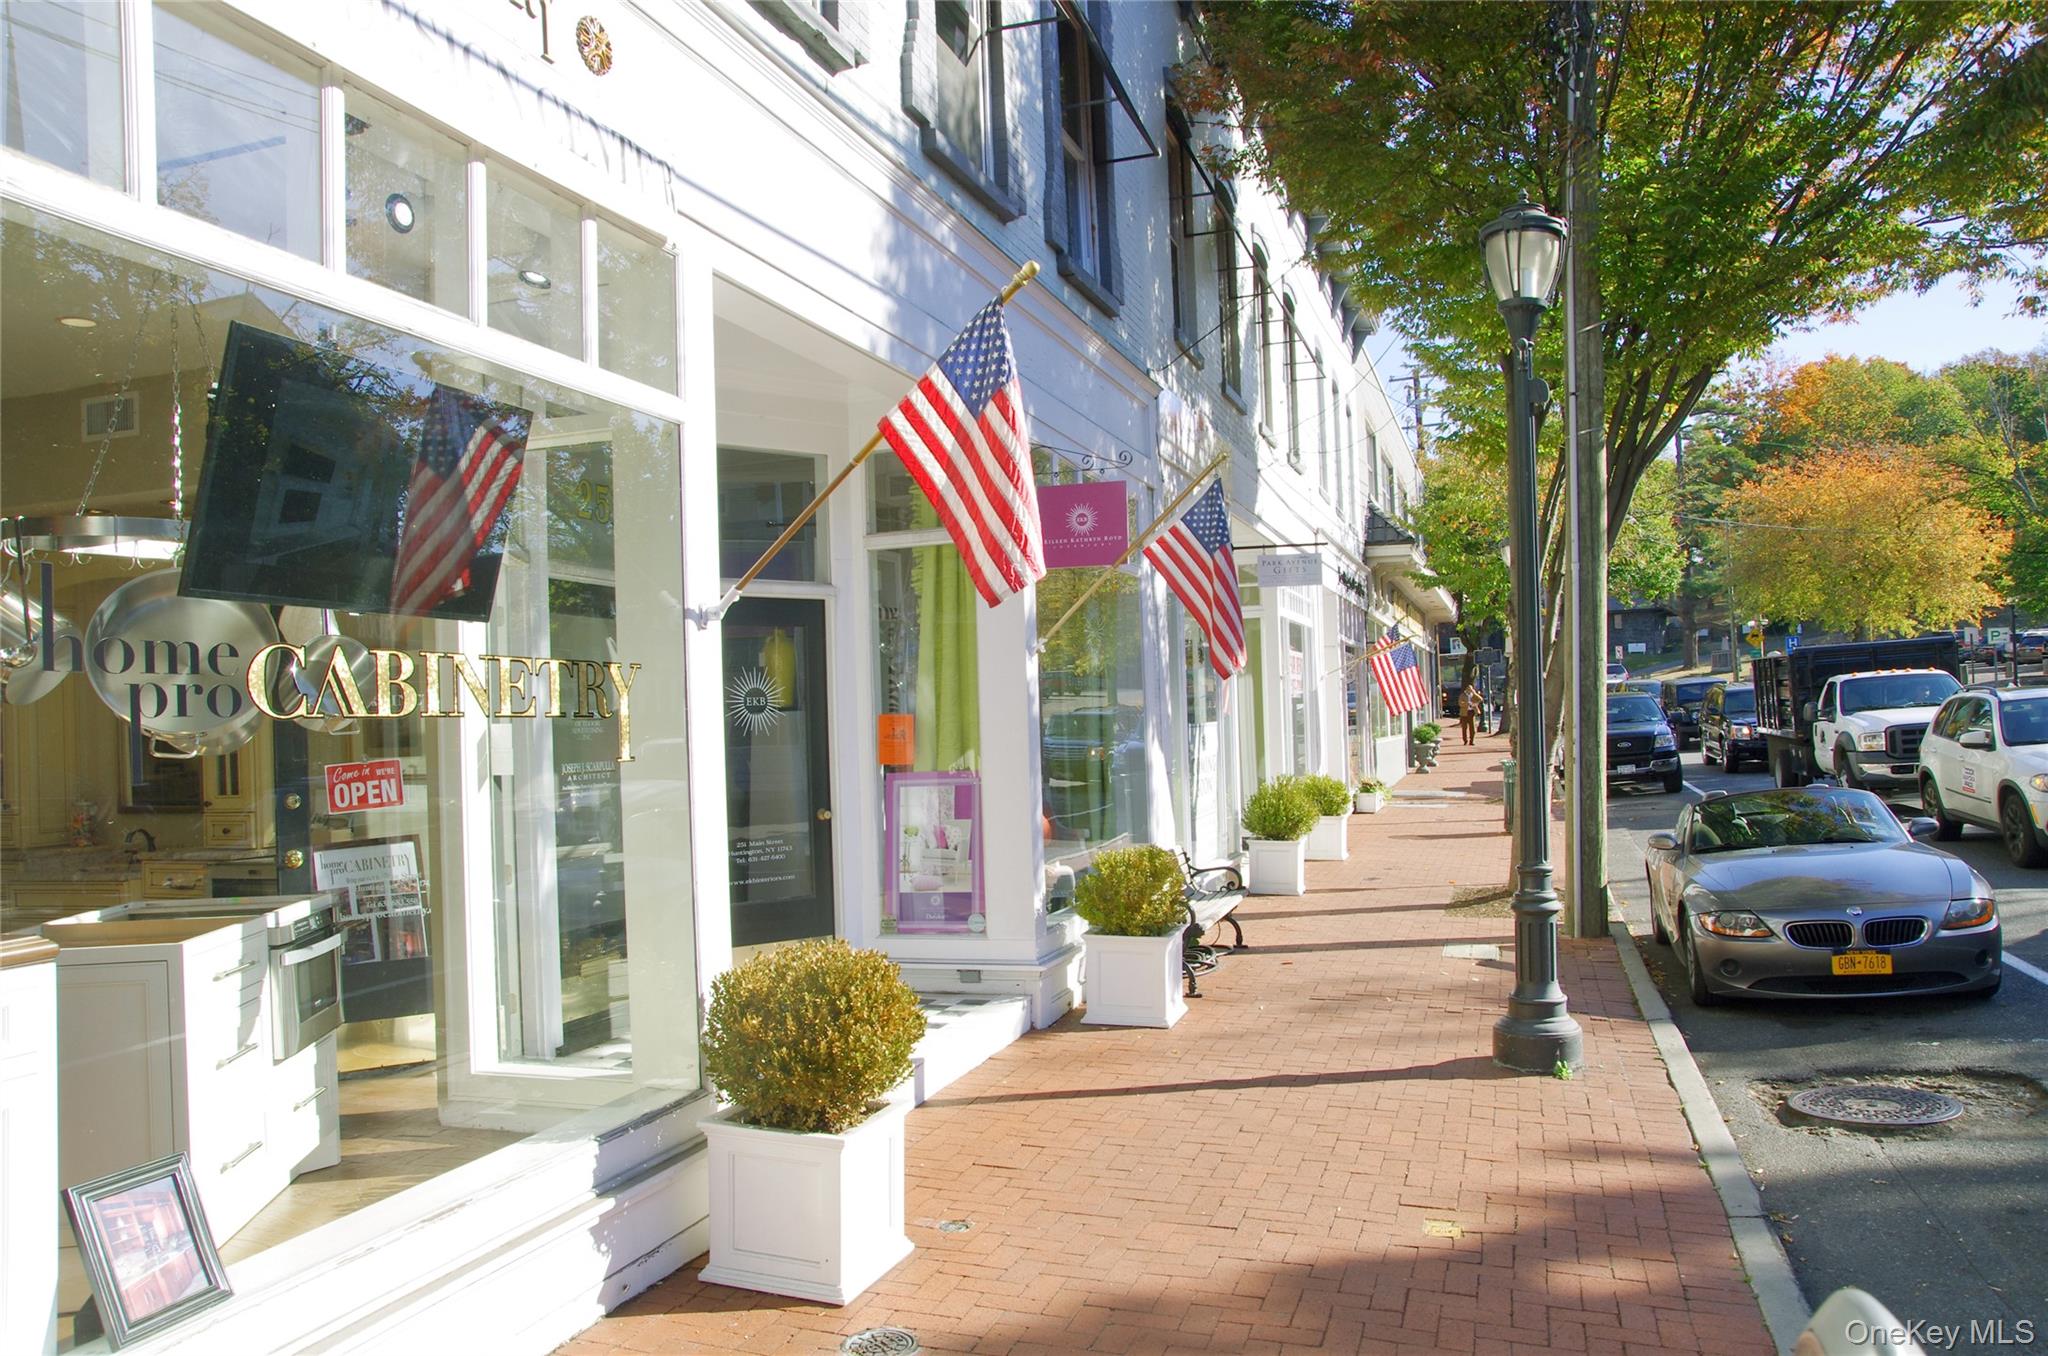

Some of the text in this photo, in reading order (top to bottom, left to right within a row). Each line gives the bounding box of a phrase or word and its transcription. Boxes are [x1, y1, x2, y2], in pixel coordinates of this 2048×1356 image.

[1273, 566, 1307, 575] GIFTS
[40, 561, 240, 677] home
[1990, 630, 2001, 641] P
[1788, 638, 1798, 648] H
[246, 643, 642, 763] CABINETRY
[746, 696, 766, 706] EKB
[124, 682, 243, 786] pro
[333, 766, 395, 783] Come in WE'RE
[567, 772, 611, 781] ARCHITECT
[334, 778, 398, 808] OPEN
[1838, 956, 1887, 970] GBN-7618
